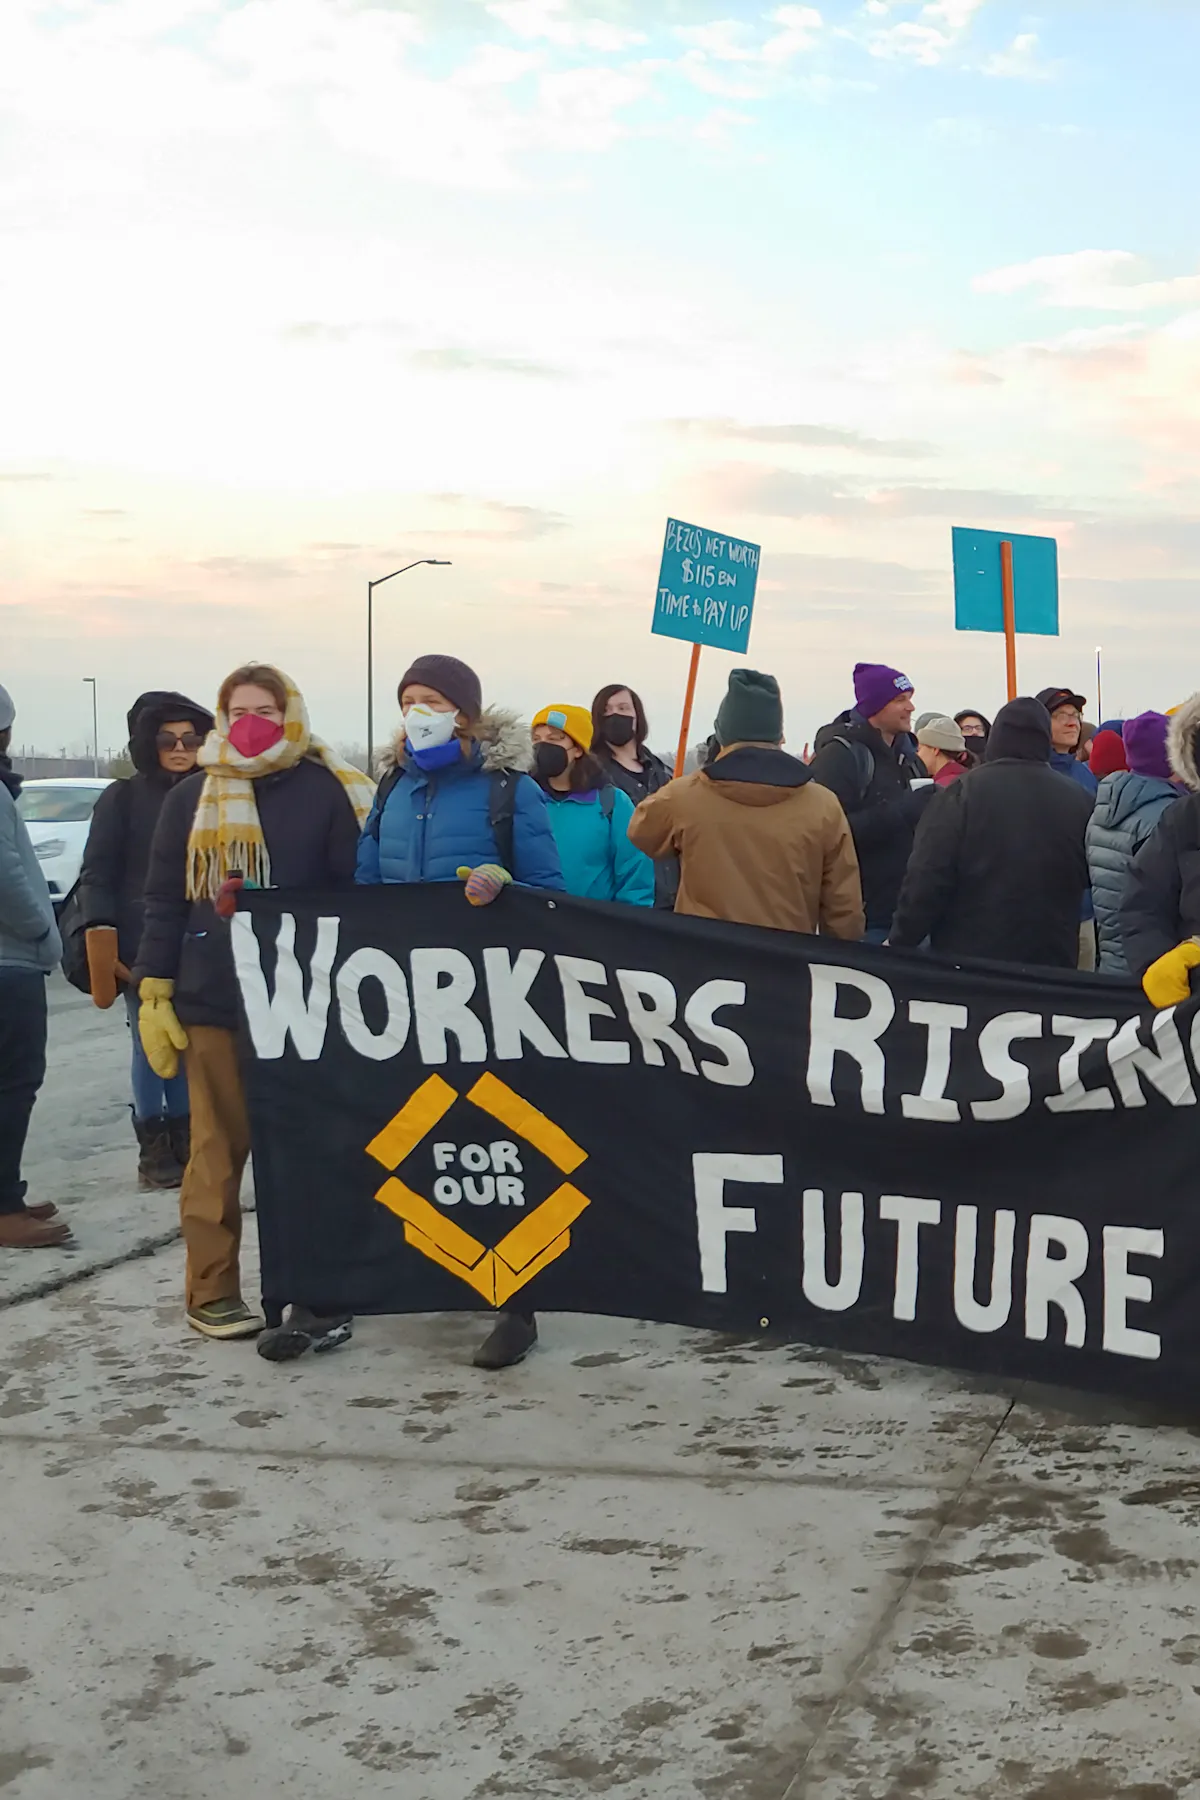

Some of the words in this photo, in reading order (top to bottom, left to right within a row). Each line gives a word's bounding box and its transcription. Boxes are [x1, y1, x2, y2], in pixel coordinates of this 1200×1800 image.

[705, 537, 726, 558] NET
[728, 542, 759, 571] WORTH
[681, 557, 715, 588] $115
[718, 571, 737, 587] BN
[659, 588, 690, 618] TIME
[702, 597, 728, 628] PAY
[730, 604, 749, 632] UP
[231, 911, 755, 1087] WORKERS
[433, 1140, 524, 1174] FOR
[433, 1175, 525, 1207] OUR
[692, 1152, 1165, 1360] FUTURE
